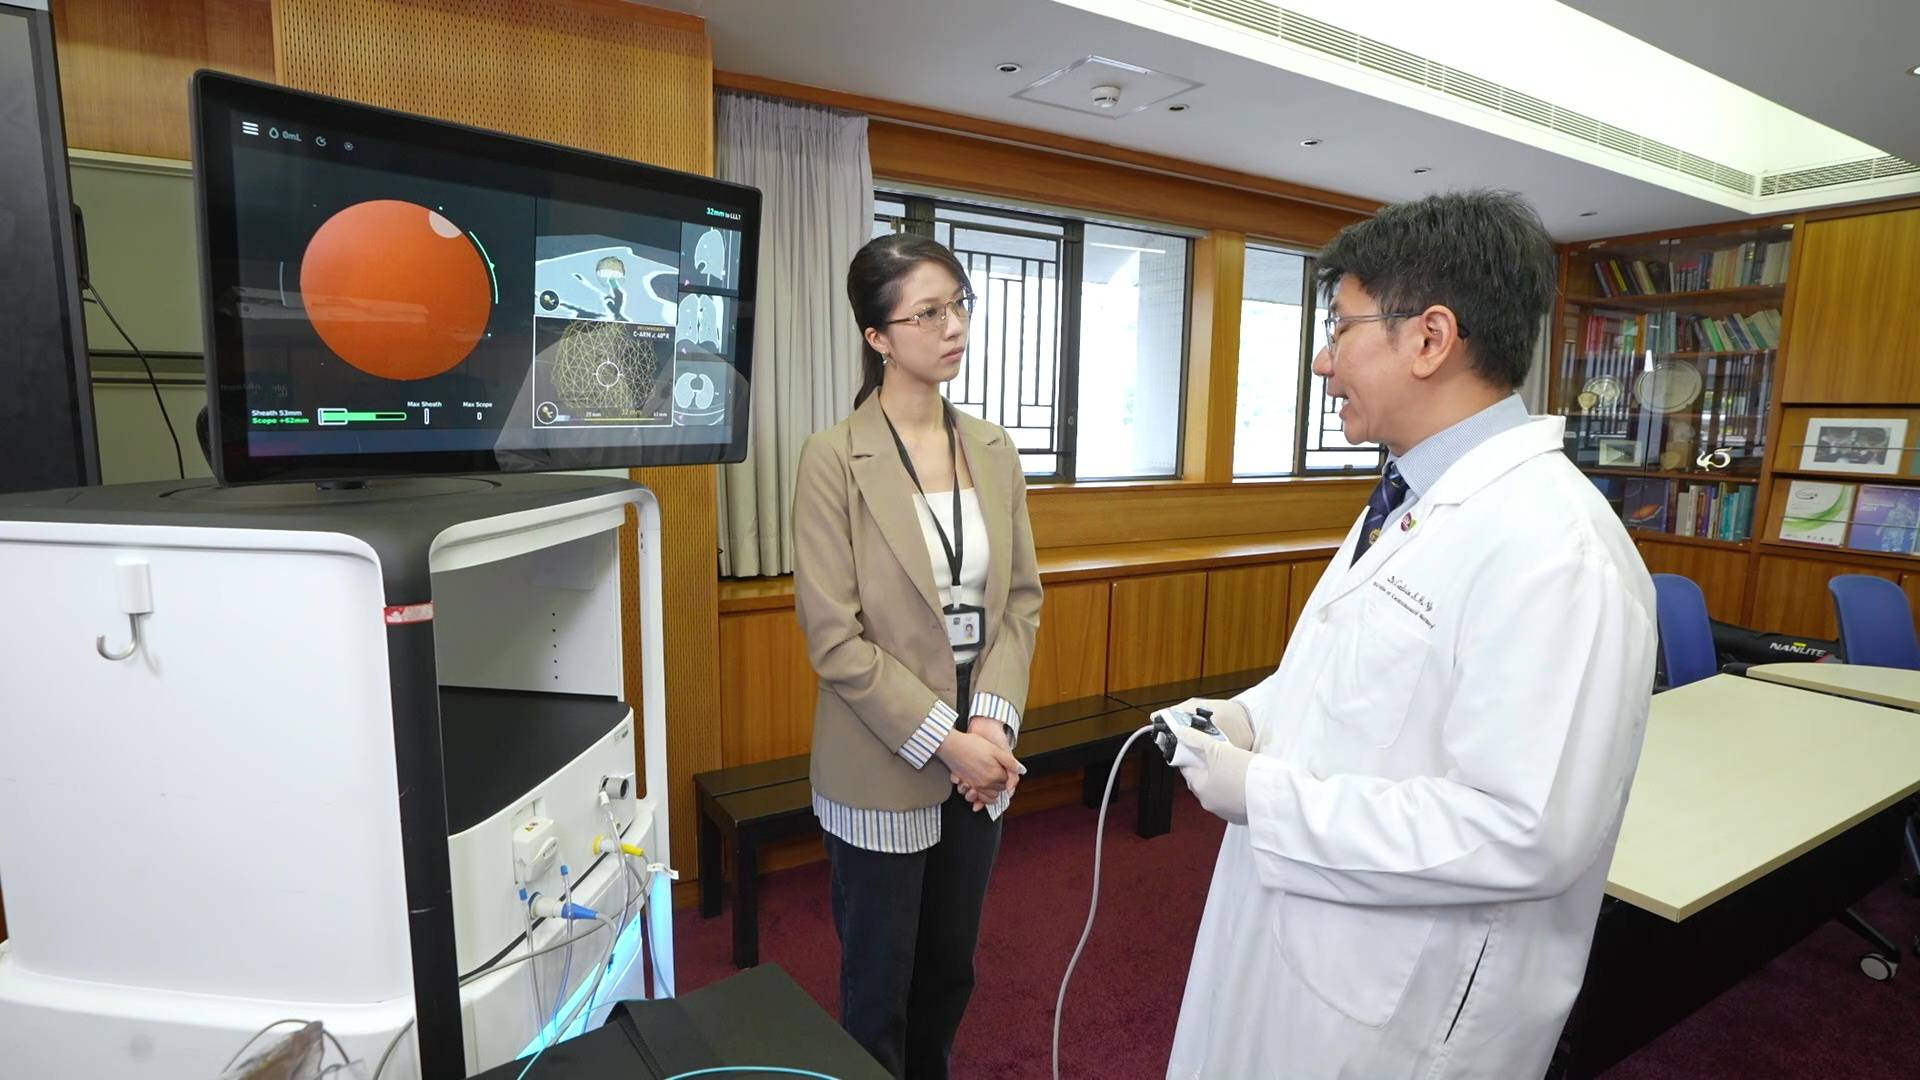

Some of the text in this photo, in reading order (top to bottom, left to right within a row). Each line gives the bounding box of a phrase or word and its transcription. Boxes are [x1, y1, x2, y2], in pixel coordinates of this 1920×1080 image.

[251, 409, 278, 417] Sheath
[252, 417, 278, 425] Scope
[1769, 642, 1827, 657] NANLITE
